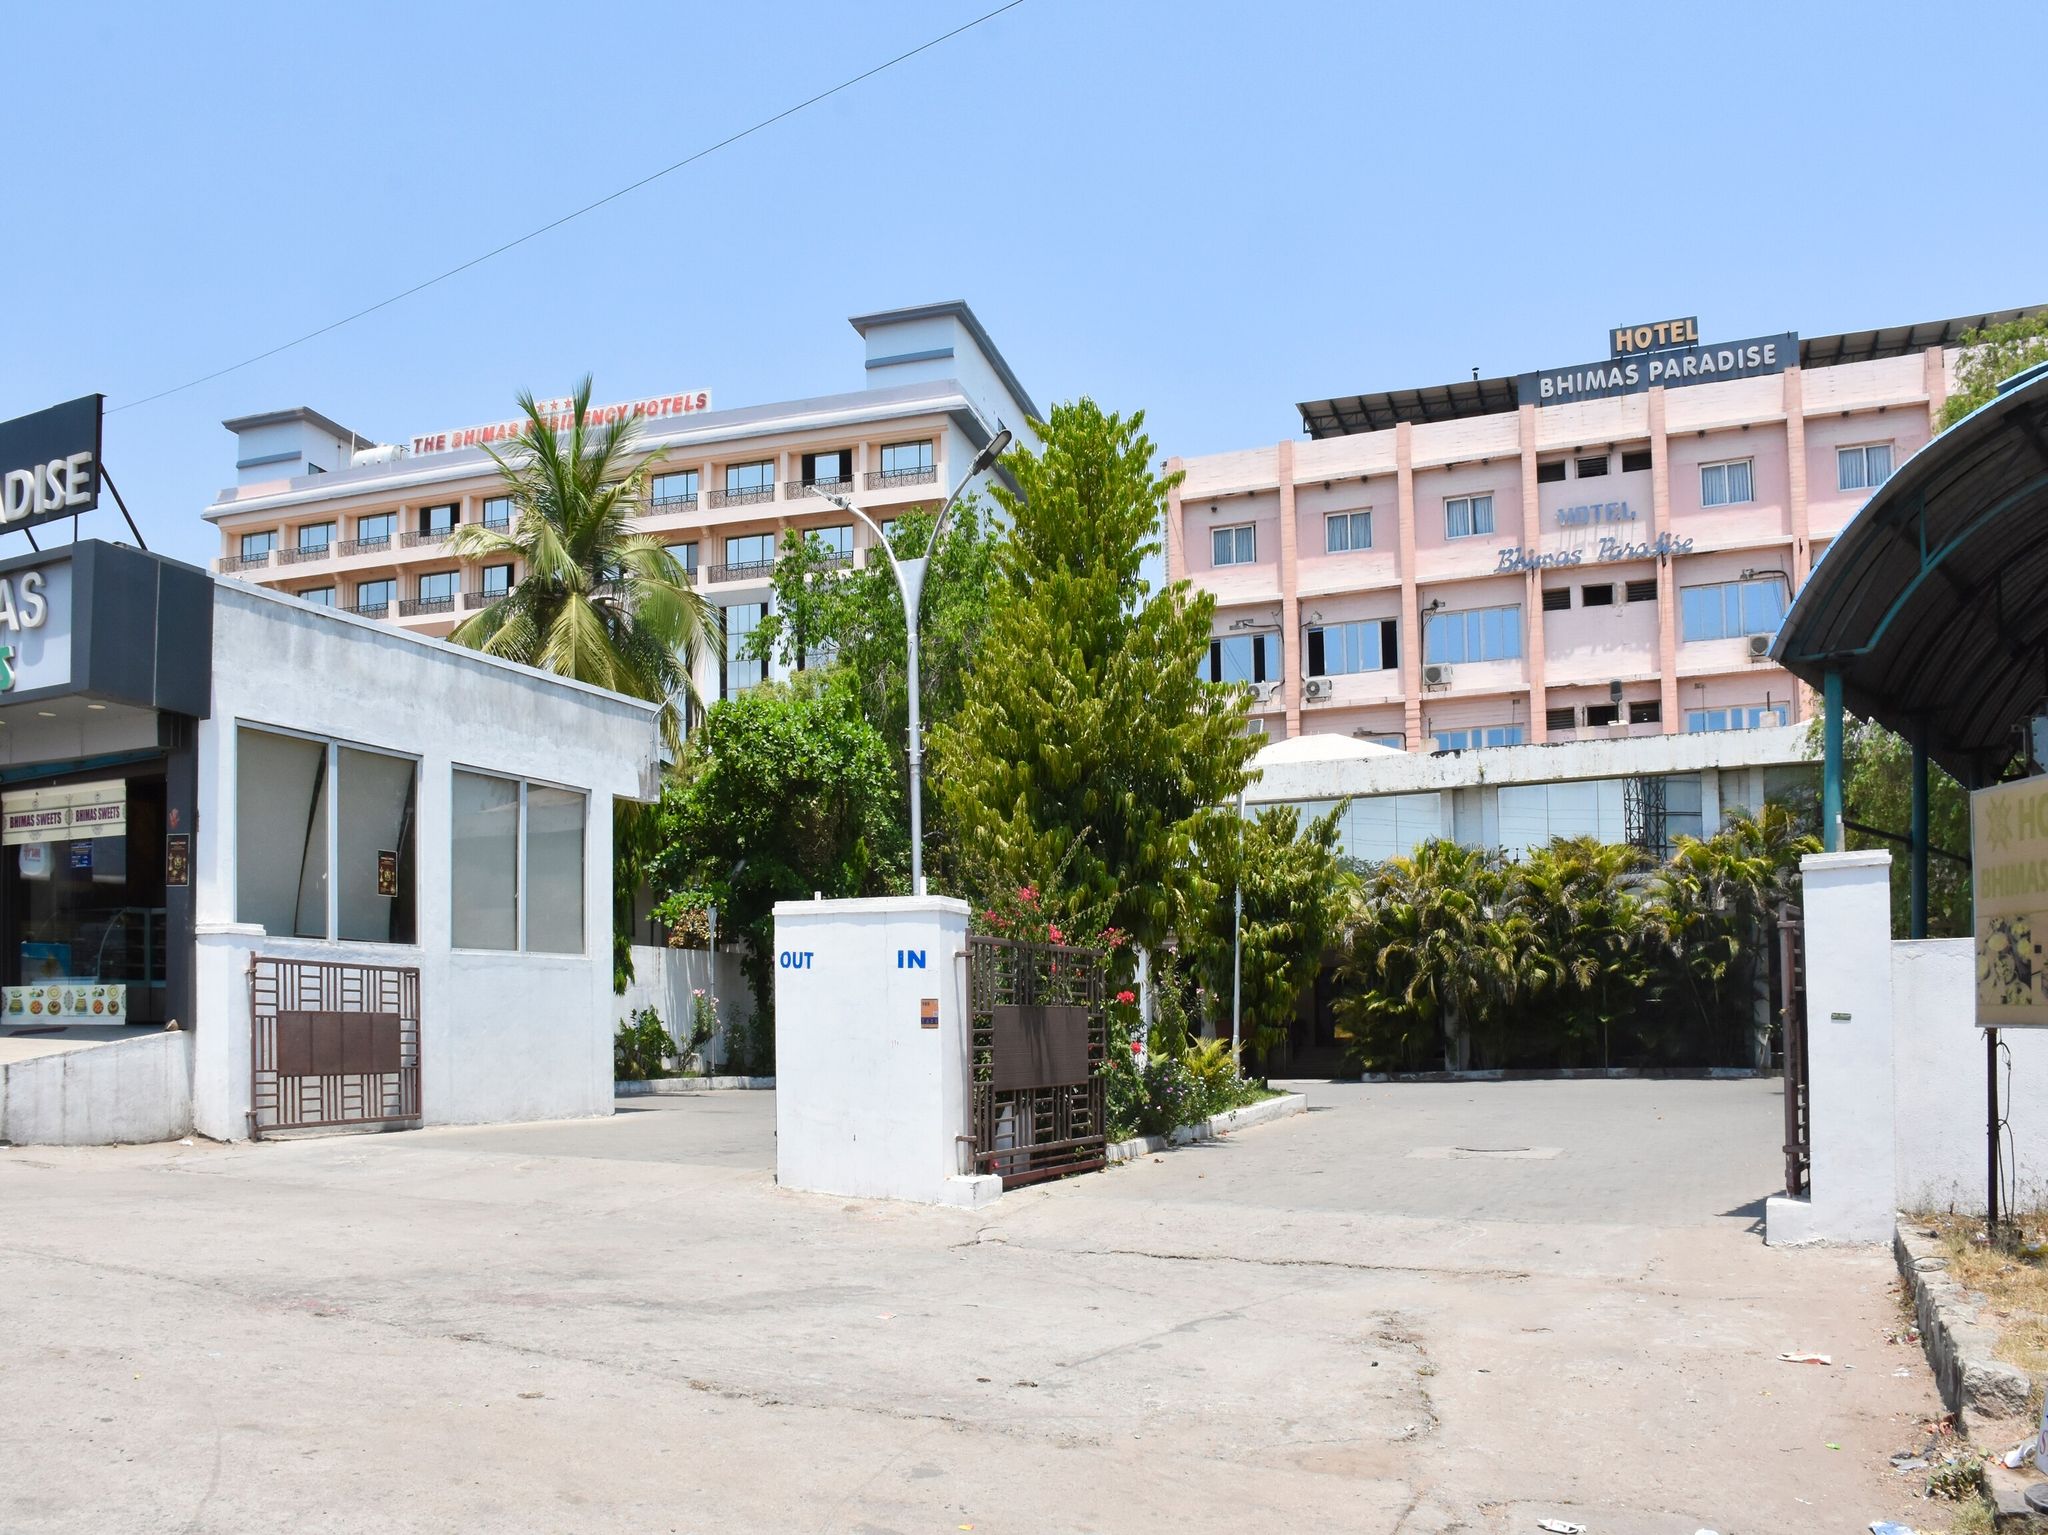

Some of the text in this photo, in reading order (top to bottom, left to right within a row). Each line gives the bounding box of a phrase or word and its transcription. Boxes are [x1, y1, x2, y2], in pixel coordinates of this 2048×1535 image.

[1616, 320, 1698, 351] HOTEL
[1540, 344, 1776, 398] BHIMAS PARADISE
[414, 434, 446, 454] THE
[451, 422, 518, 448] BHIMAS
[633, 392, 707, 418] HOTELS
[0, 451, 92, 524] DISE
[1556, 502, 1636, 527] HOTEL
[9, 806, 120, 828] BHIMAS SWEETS BHIMAS SWEETS
[780, 949, 926, 969] OUT IN
